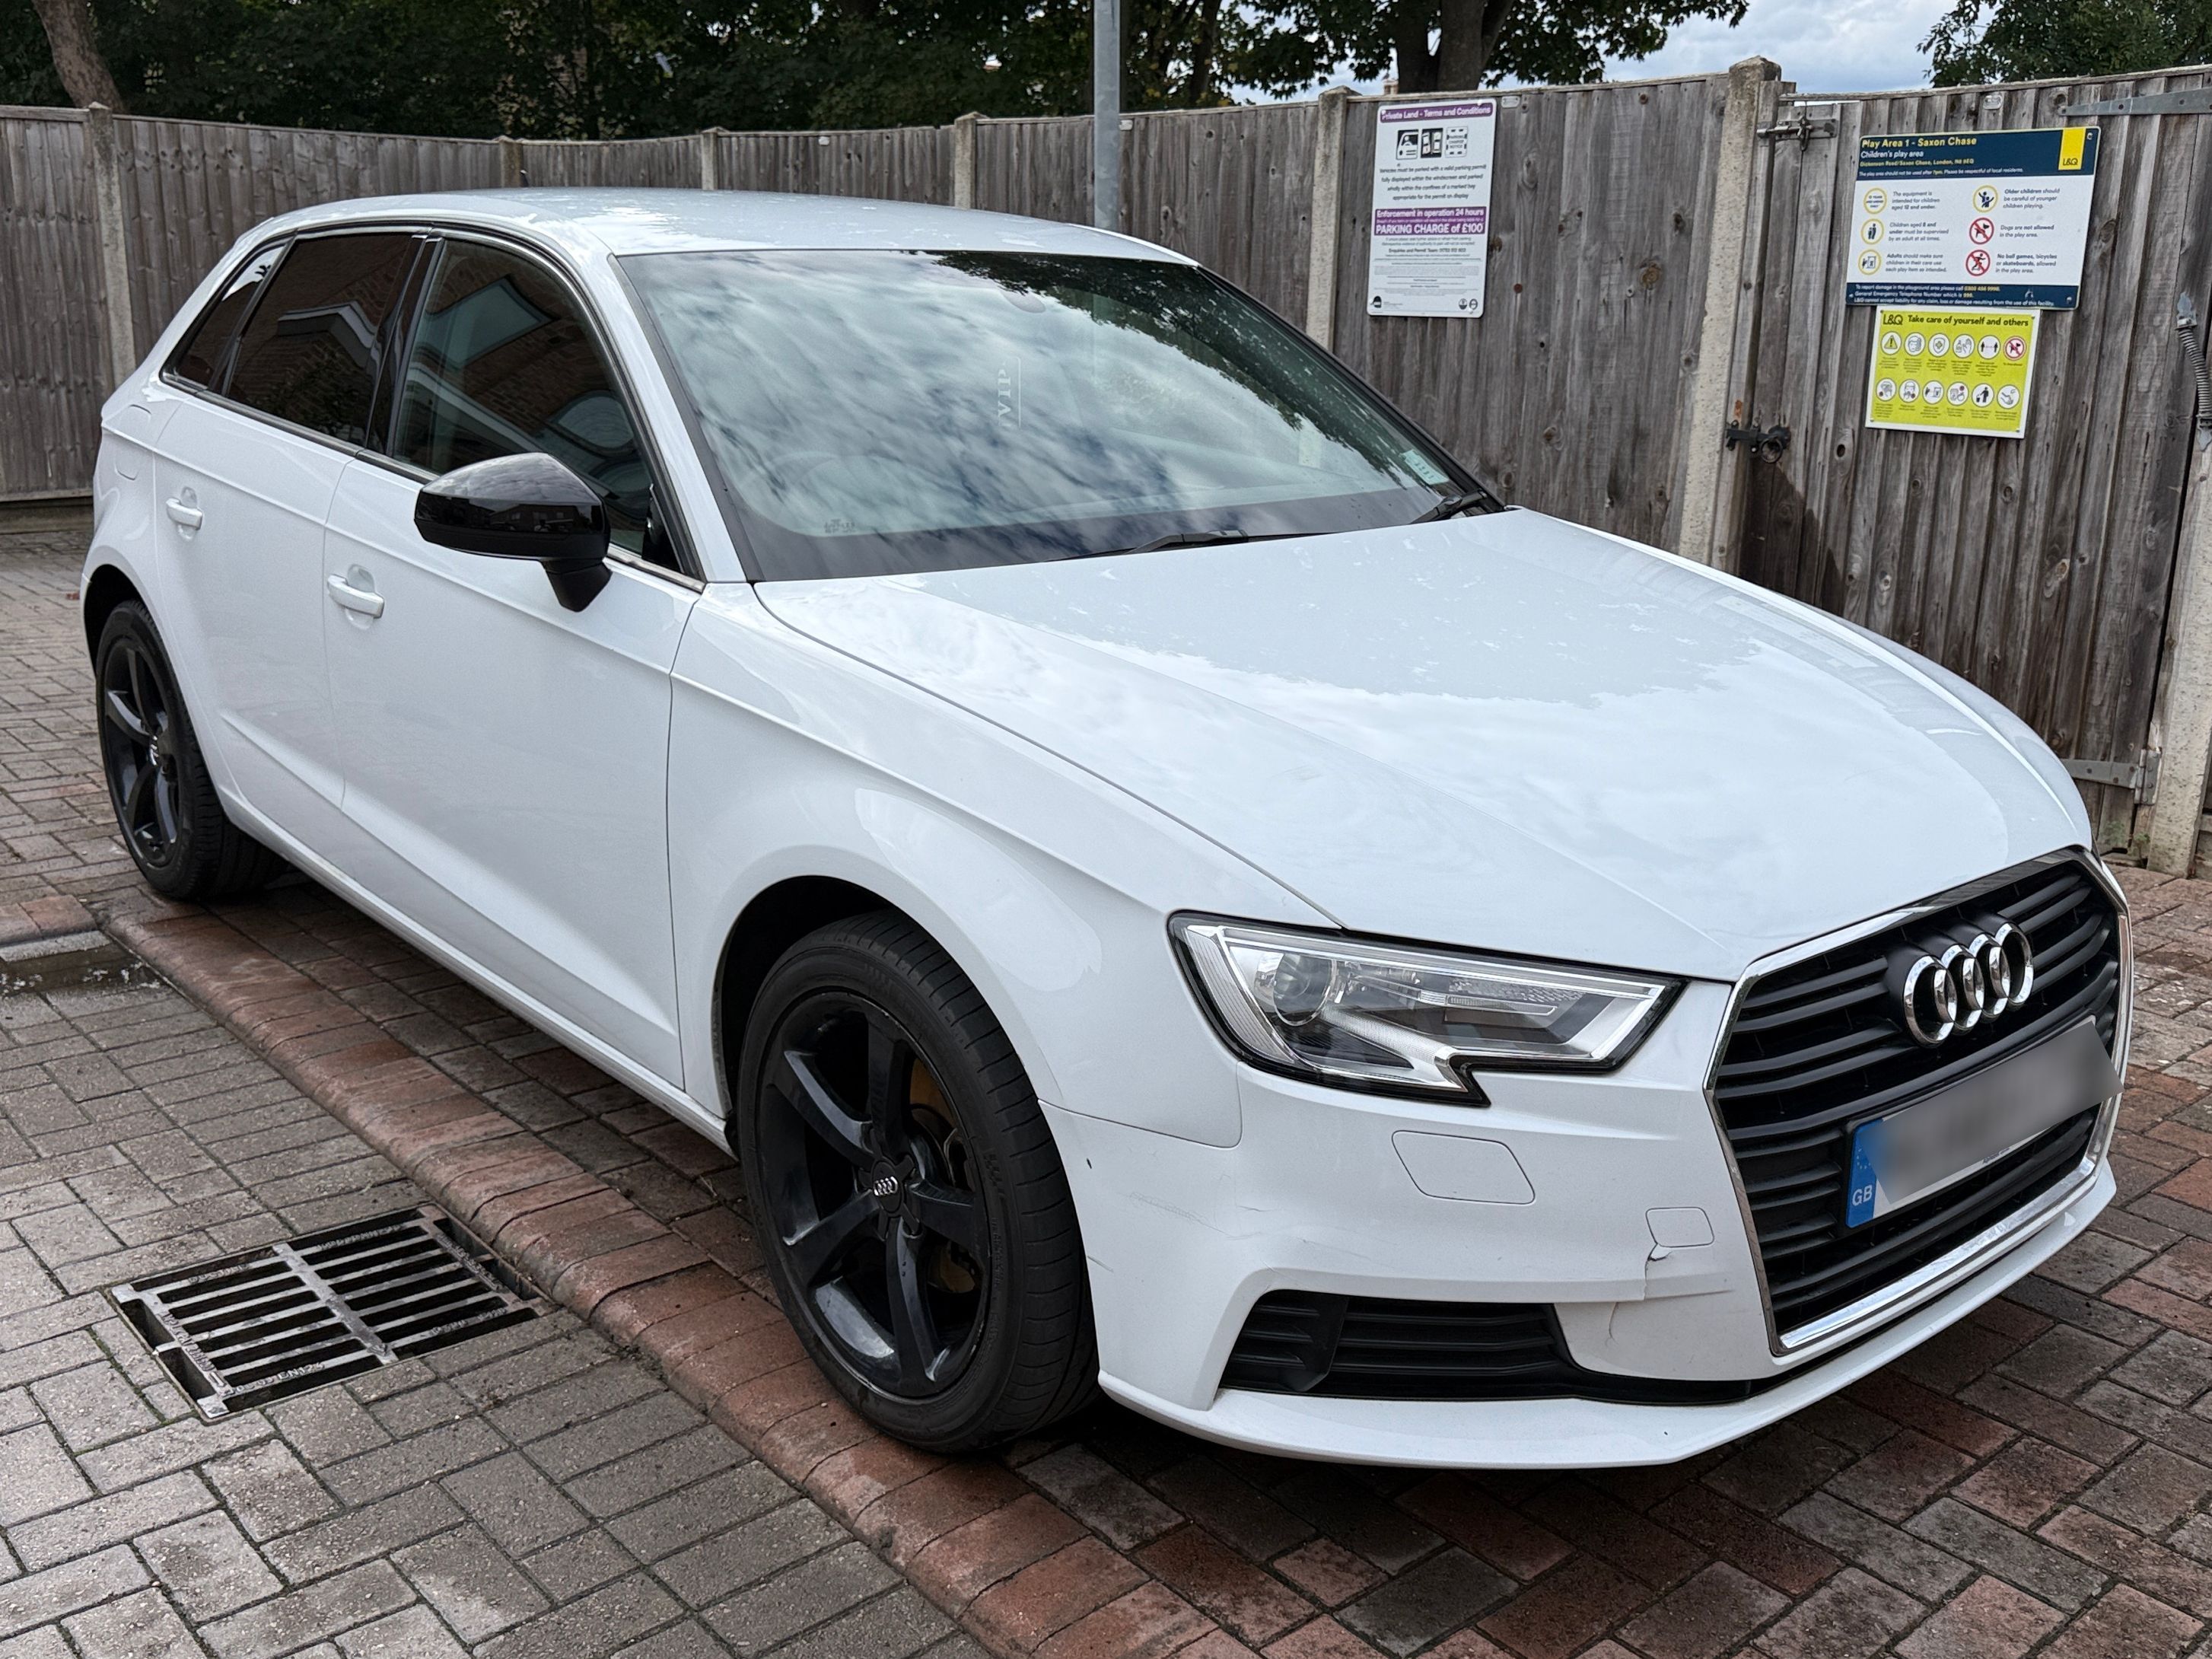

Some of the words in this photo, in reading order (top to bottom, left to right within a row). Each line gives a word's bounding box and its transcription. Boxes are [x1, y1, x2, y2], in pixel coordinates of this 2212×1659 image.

[1381, 112, 1402, 120] Private
[1404, 110, 1419, 119] Land
[1424, 109, 1443, 117] Terms
[1443, 108, 1456, 116] and
[1456, 107, 1491, 116] Conditions
[1862, 139, 1880, 149] Play
[1882, 139, 1903, 148] Area
[1905, 139, 1910, 147] 1
[1918, 138, 1946, 147] Saxon
[1948, 137, 1977, 146] Chase
[1860, 150, 1893, 158] Children's
[1893, 150, 1908, 158] play
[2062, 158, 2079, 166] L&Q
[1377, 209, 1416, 218] Enforcement
[1417, 209, 1423, 217] in
[1424, 209, 1454, 218] operation
[1455, 208, 1464, 216] 24
[1465, 208, 1485, 216] hours
[1376, 224, 1412, 234] PARKING
[1413, 223, 1450, 234] CHARGE
[1450, 223, 1461, 233] of
[1462, 222, 1484, 233] £100
[1883, 314, 1904, 325] L&Q
[1908, 314, 1924, 323] Take
[1943, 315, 1953, 323] of
[1953, 317, 1985, 326] yourself
[1986, 317, 2002, 326] and
[2003, 317, 2029, 326] others
[998, 368, 1011, 418] VIP
[1852, 1185, 1873, 1206] GB
